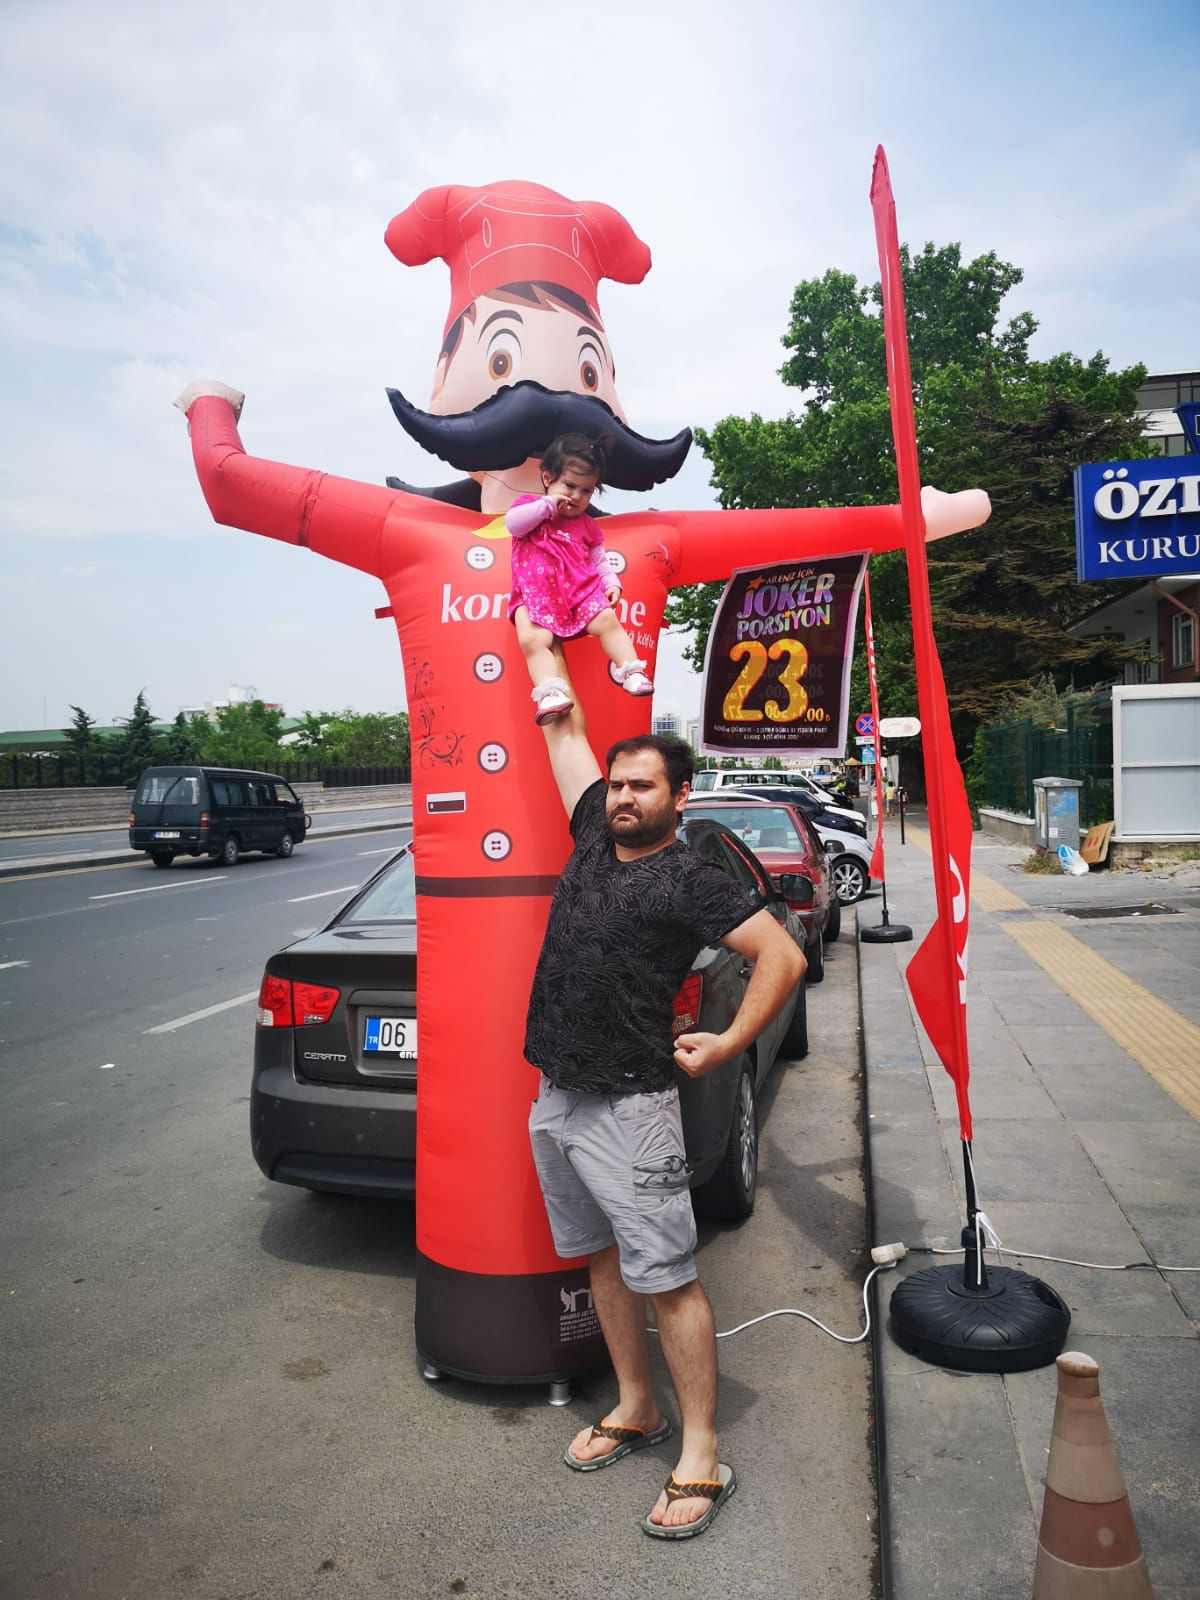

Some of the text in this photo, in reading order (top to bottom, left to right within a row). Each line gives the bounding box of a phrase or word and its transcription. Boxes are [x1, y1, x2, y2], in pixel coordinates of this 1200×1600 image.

[736, 573, 836, 619] JOKER
[736, 604, 831, 641] PORSİYON
[368, 1022, 406, 1047] TR 06
[303, 1051, 347, 1062] CERATO
